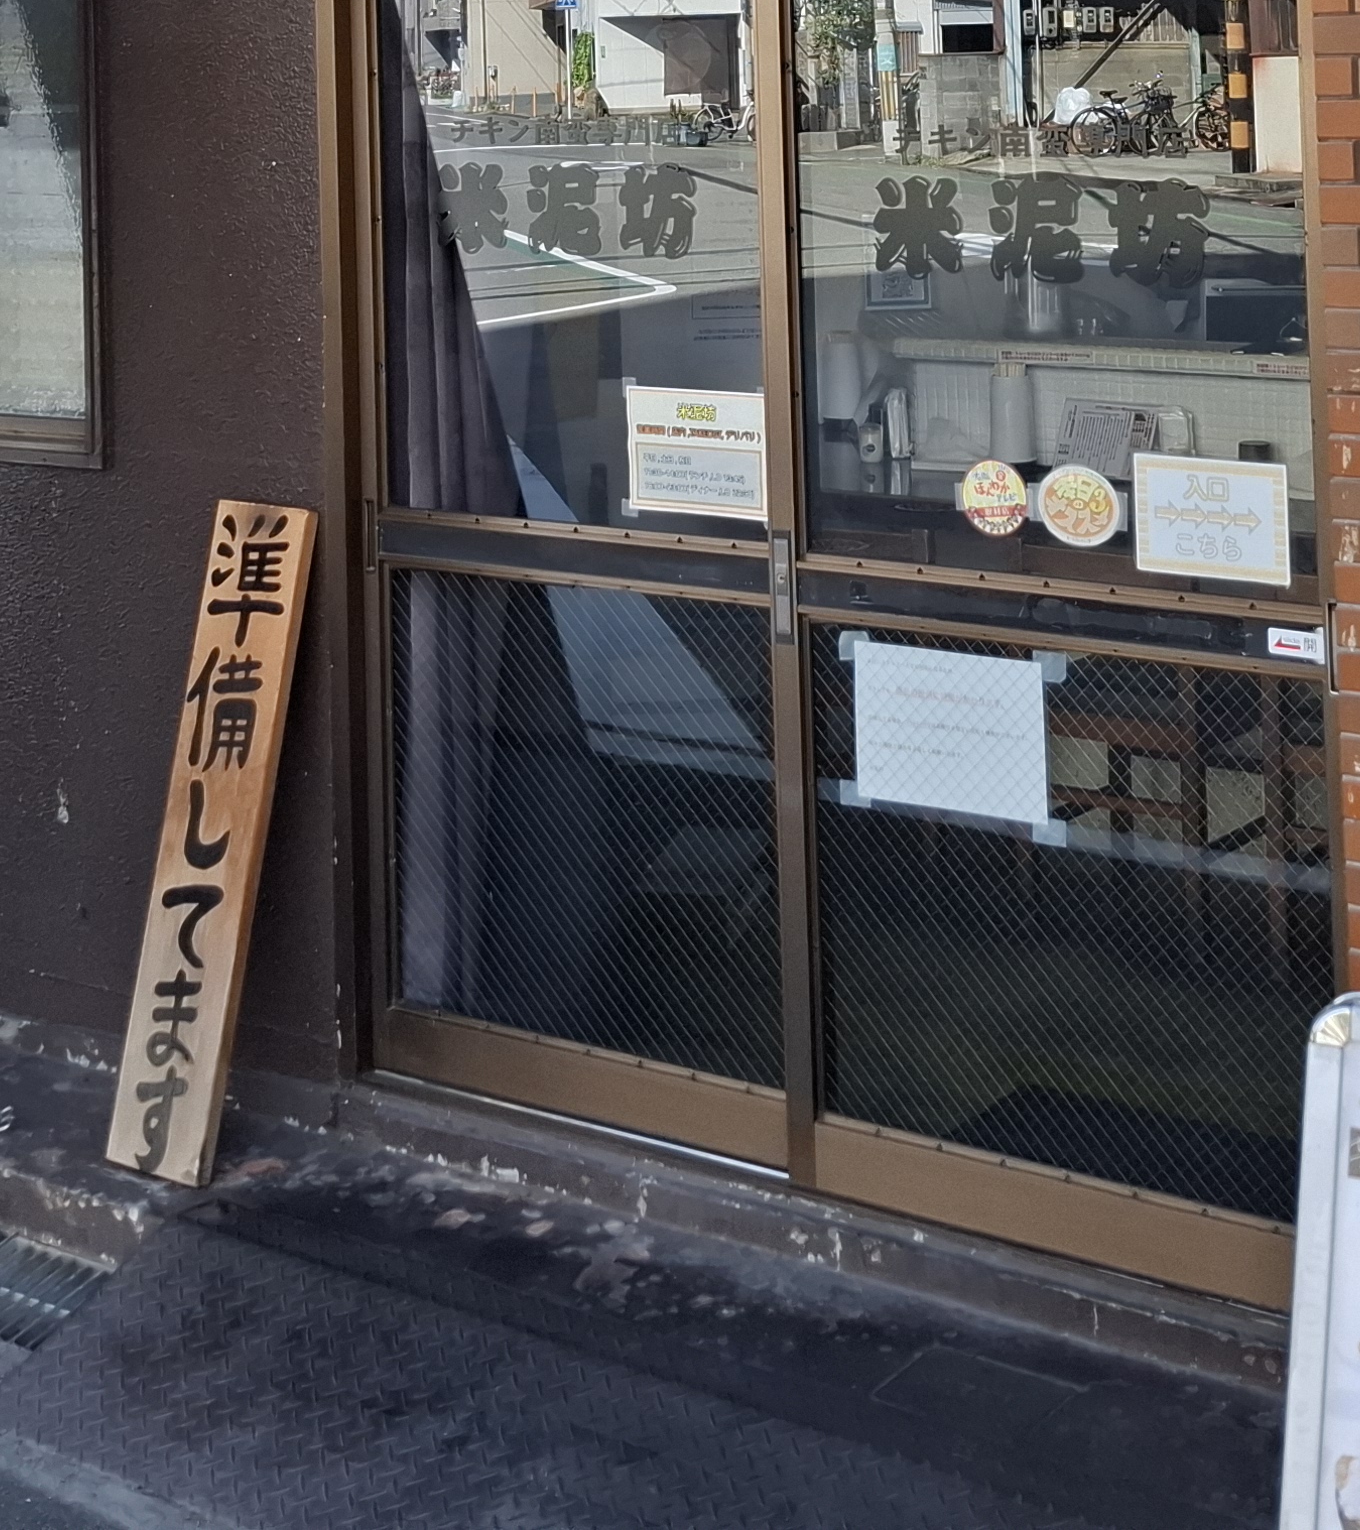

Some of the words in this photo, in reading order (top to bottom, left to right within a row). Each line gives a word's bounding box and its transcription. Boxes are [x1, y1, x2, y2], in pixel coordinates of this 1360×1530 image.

[437, 161, 698, 259] 米泥坊
[873, 173, 1211, 287] 米泥坊
[1183, 475, 1229, 503] 入口
[1175, 533, 1243, 561] こちら
[135, 513, 291, 1173] 準備してます
